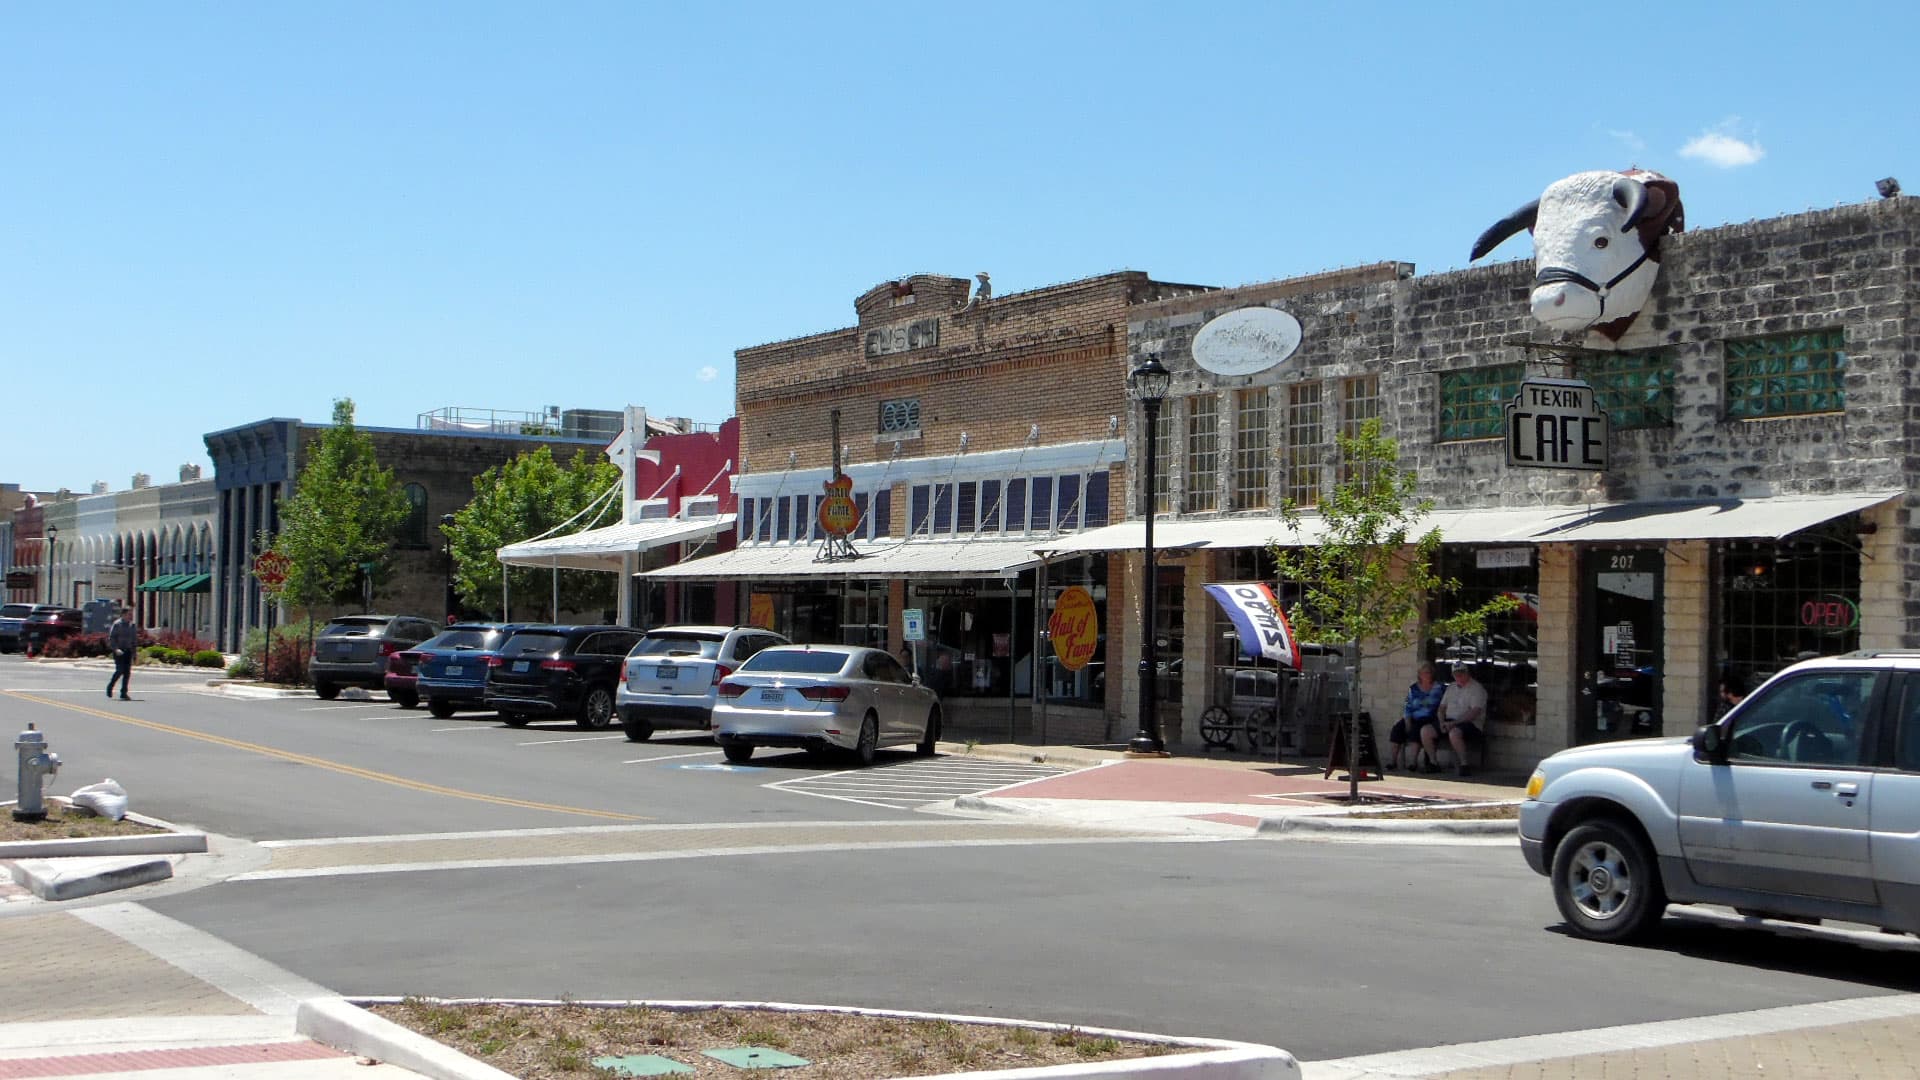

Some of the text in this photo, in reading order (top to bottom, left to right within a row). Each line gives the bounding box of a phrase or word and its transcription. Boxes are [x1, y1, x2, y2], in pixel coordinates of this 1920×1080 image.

[1529, 387, 1583, 409] TEXAN
[1512, 412, 1604, 465] CAFE
[1610, 555, 1635, 569] 207
[1049, 612, 1076, 639] Hall
[1235, 588, 1286, 650] OPEN
[1802, 601, 1849, 626] OPEN
[1066, 632, 1096, 659] Fame
